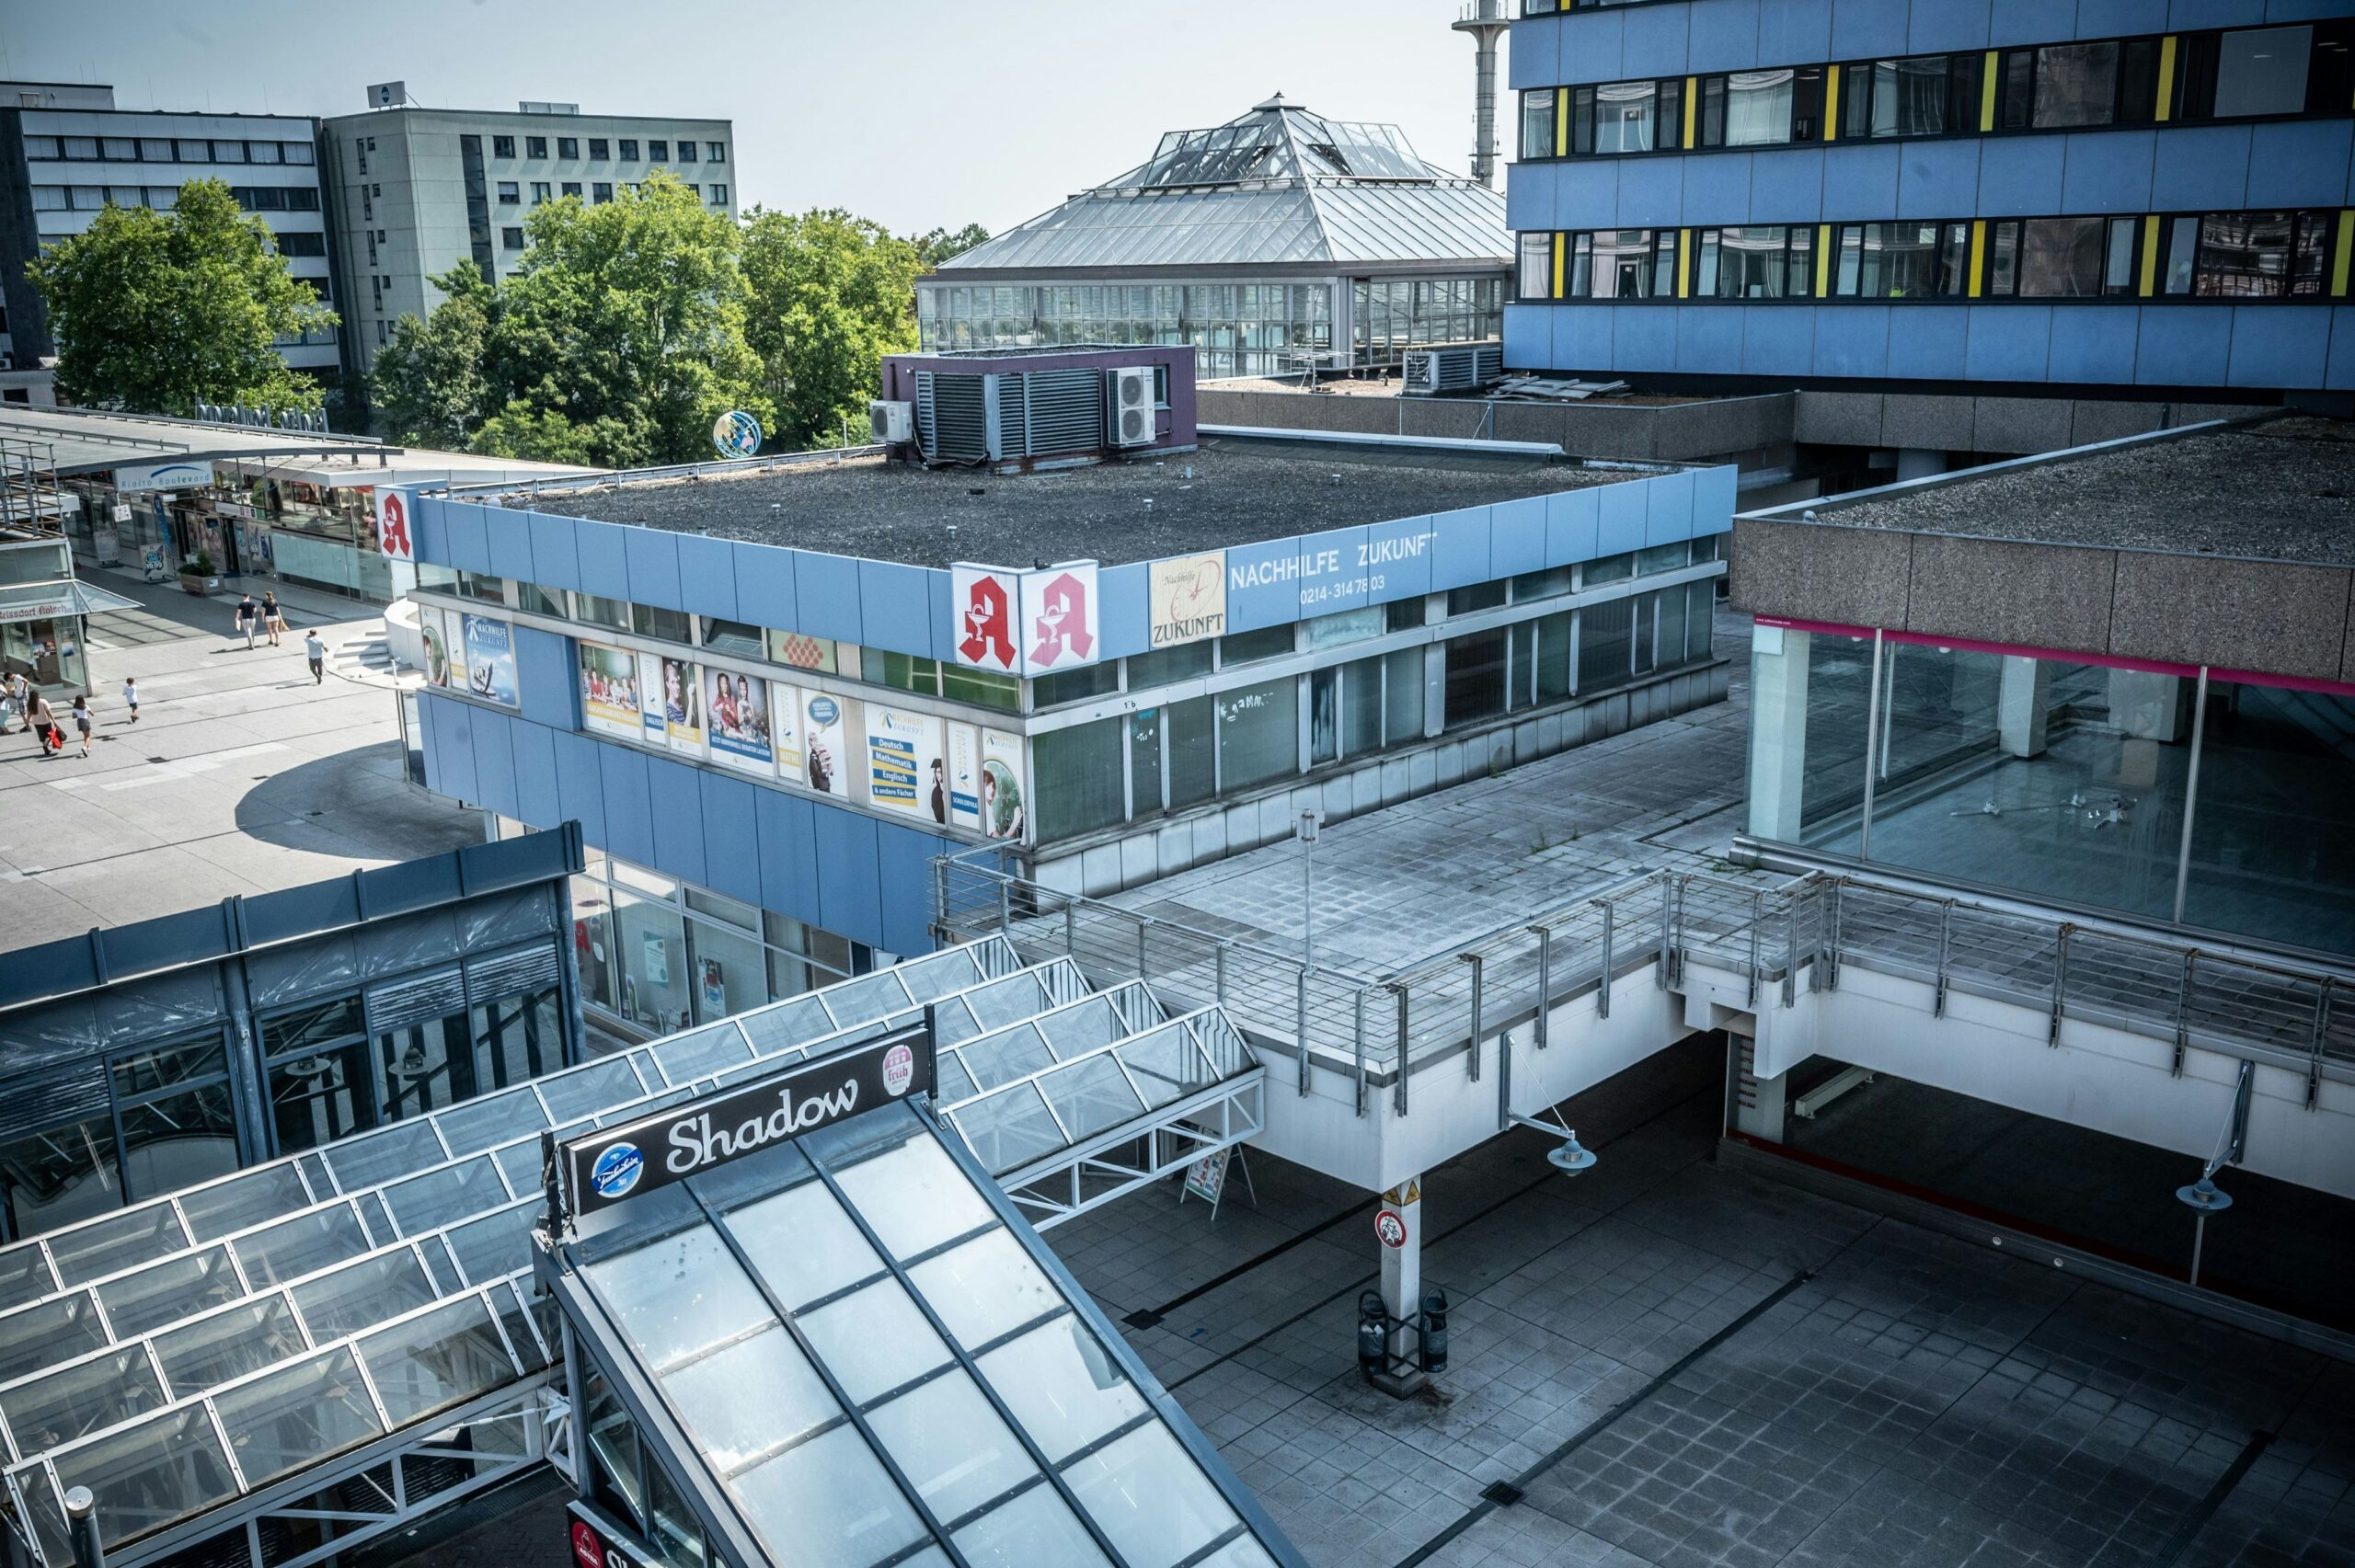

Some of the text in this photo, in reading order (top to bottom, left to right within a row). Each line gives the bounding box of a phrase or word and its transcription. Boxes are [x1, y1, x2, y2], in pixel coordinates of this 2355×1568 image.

[121, 474, 210, 488] Rialto Boulevard
[1231, 532, 1438, 590] NACHHILFE ZUKUNFT
[1165, 571, 1195, 586] Nachhilfe
[1300, 574, 1384, 605] 0214 314 78 03
[478, 624, 507, 638] NACHHILFE
[1154, 613, 1223, 644] ZUKUNFT
[893, 724, 925, 736] ZUKUNFT
[879, 738, 904, 750] Deutsch
[875, 752, 913, 769] Mathematik
[882, 770, 908, 784] Englisch
[879, 787, 896, 795] andere
[666, 1079, 858, 1173] Shadow
